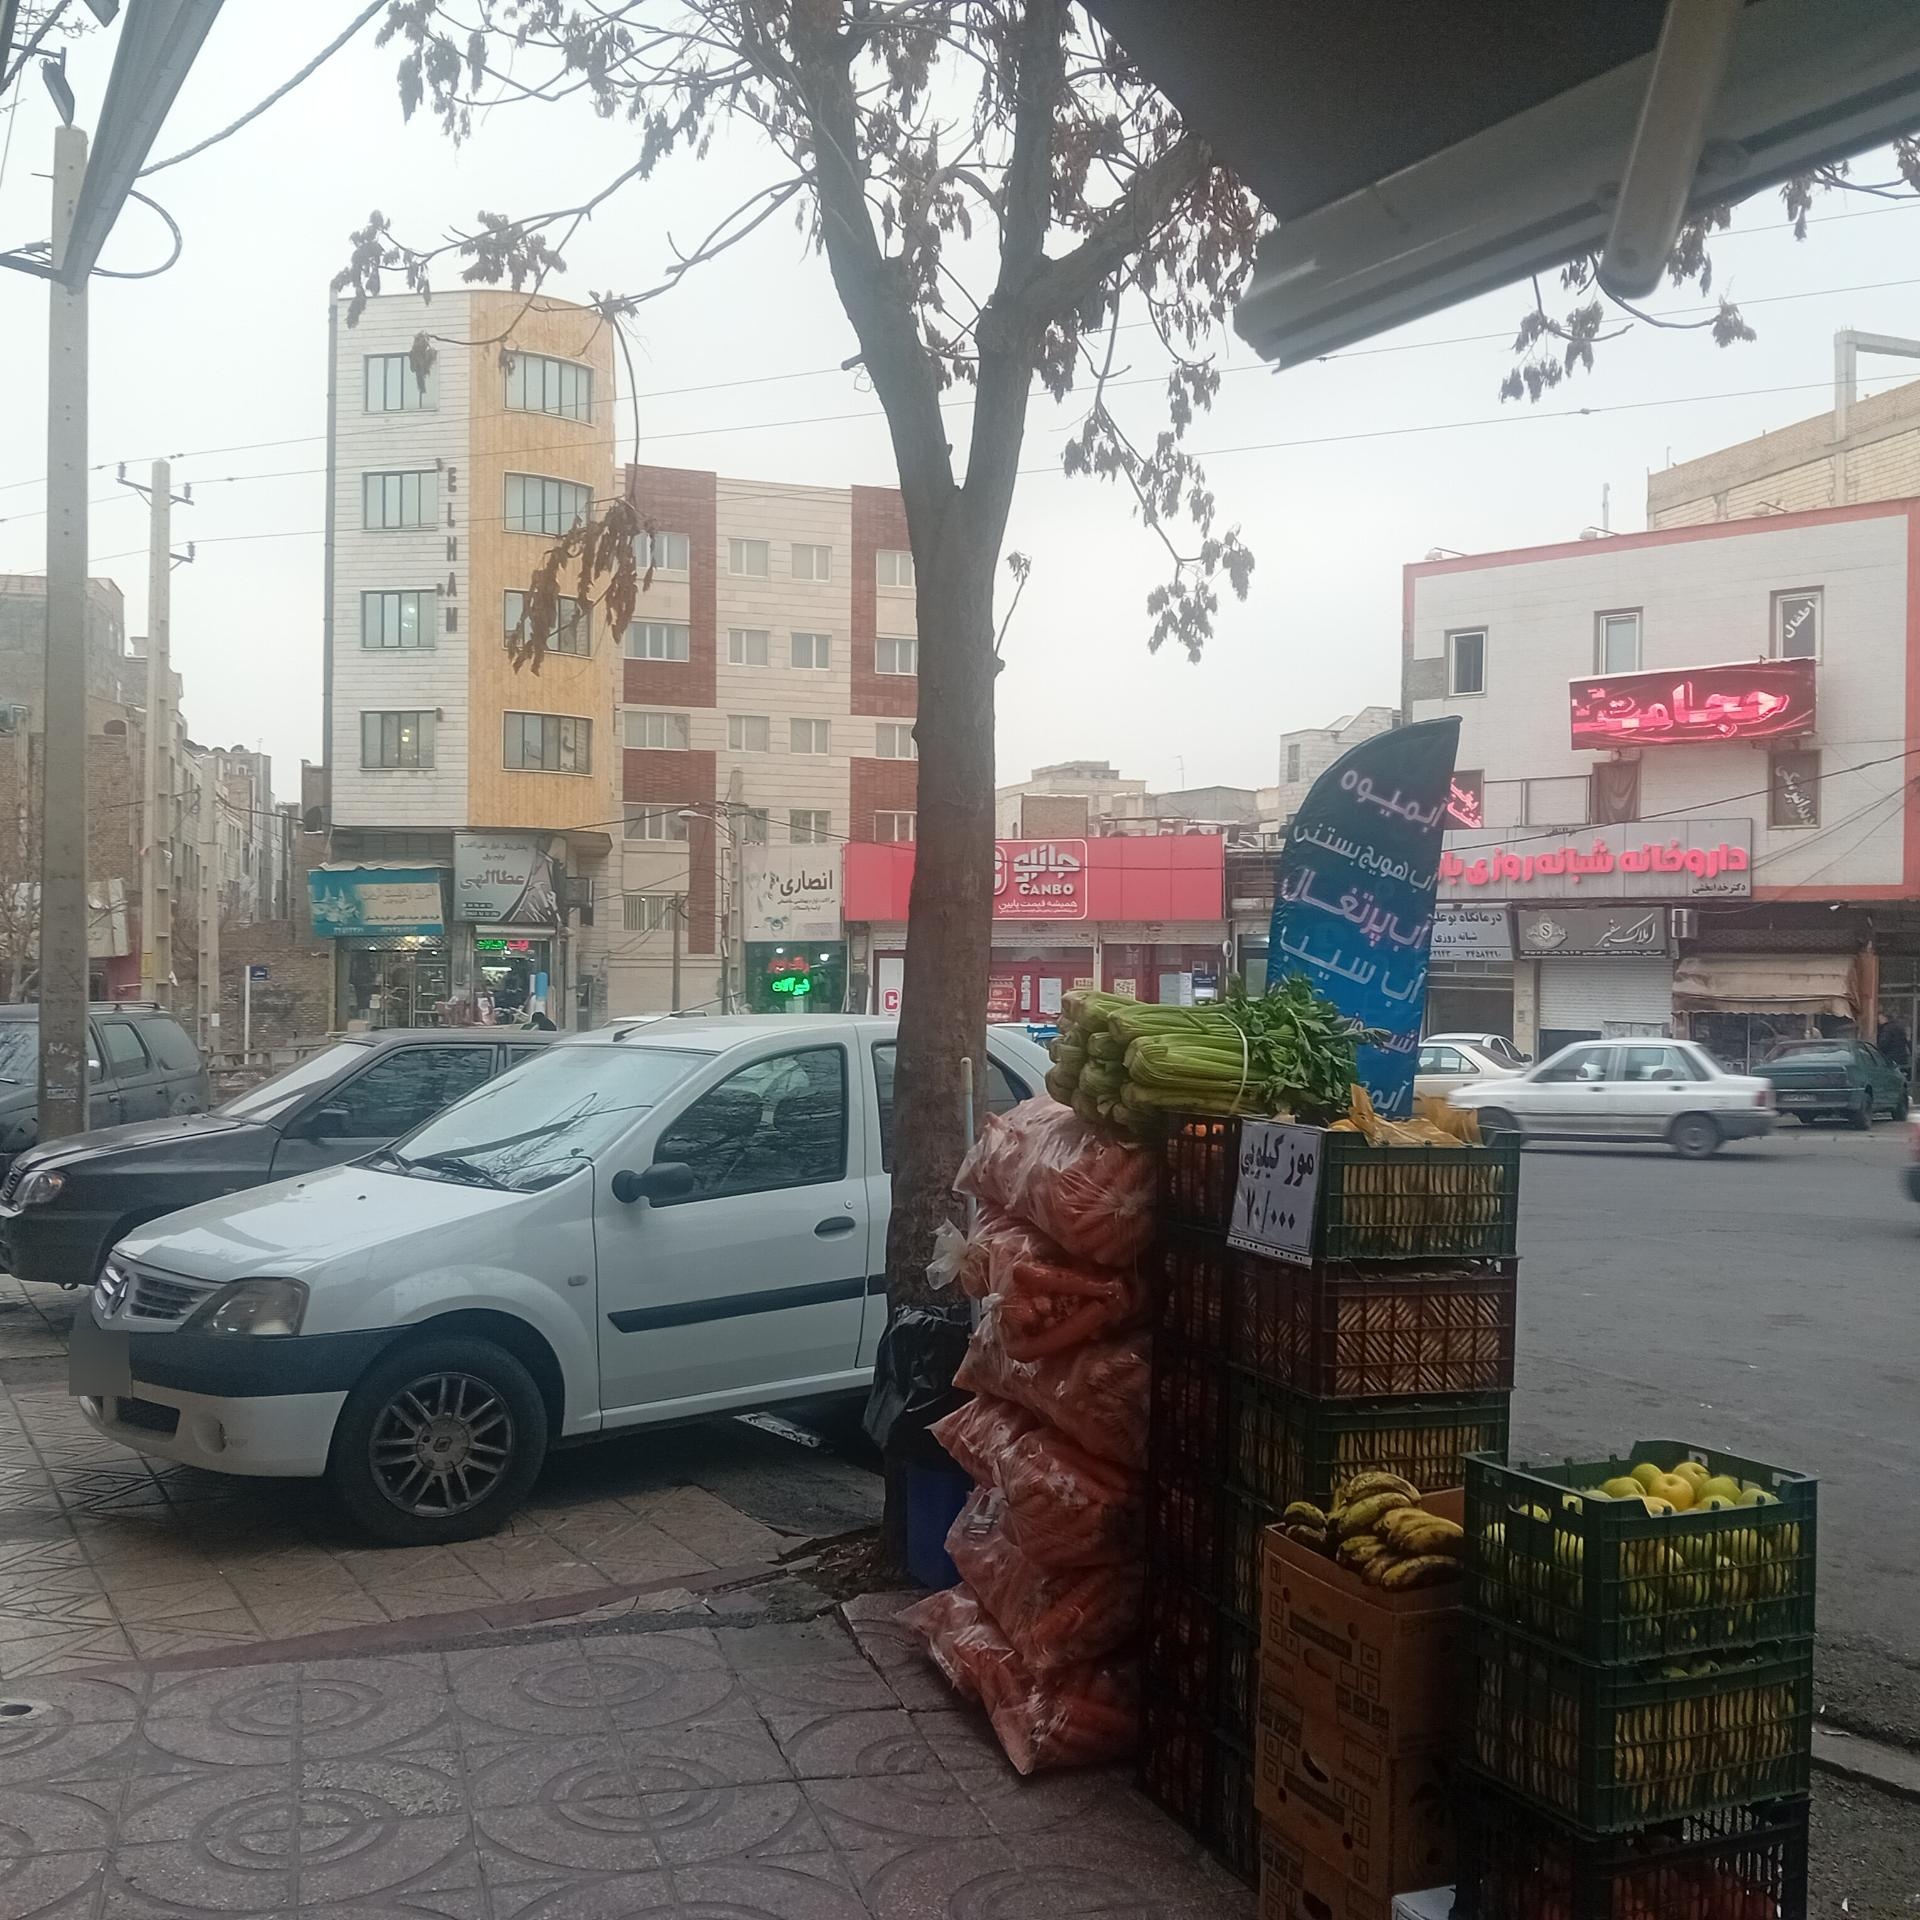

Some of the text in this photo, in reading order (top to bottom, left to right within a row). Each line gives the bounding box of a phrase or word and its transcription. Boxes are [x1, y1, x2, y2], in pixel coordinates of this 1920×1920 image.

[1785, 600, 1815, 638] اطفال
[1358, 846, 1408, 882] هویج
[1620, 841, 1748, 879] داروخانه
[780, 869, 833, 896] انصاری
[1019, 883, 1074, 896] CANBO
[1281, 868, 1391, 947] پرتغال
[1542, 924, 1550, 937] S
[1280, 926, 1428, 1008] آب سیب
[1283, 1143, 1314, 1187] موز
